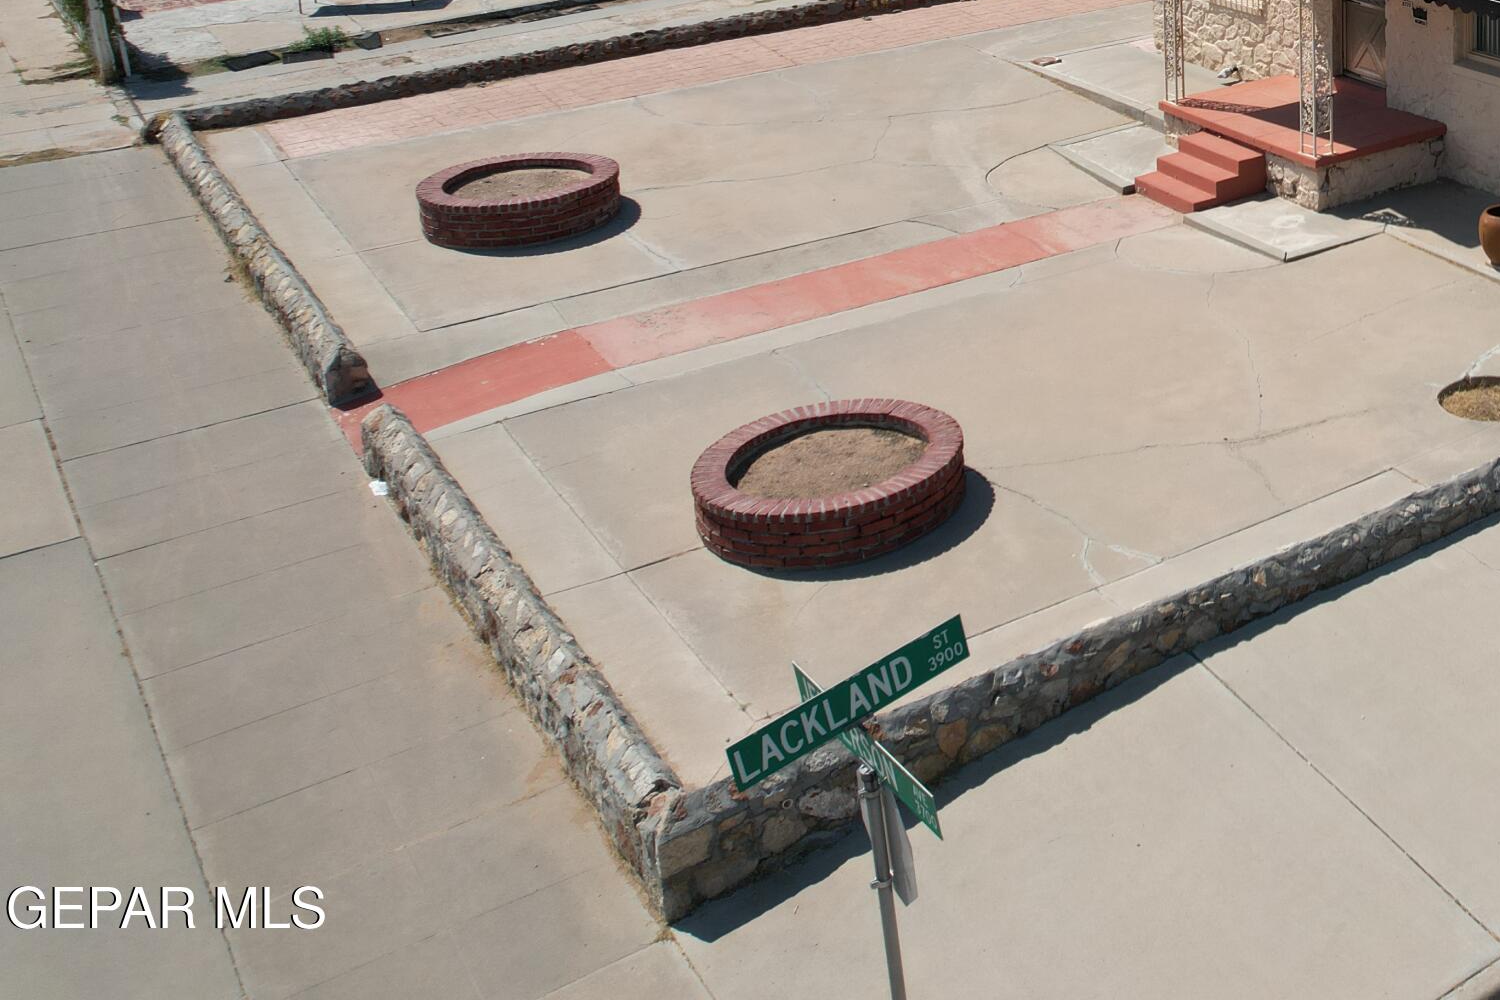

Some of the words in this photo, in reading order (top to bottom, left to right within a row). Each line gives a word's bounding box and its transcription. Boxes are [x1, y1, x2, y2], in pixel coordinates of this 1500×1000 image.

[931, 629, 950, 650] ST
[927, 642, 964, 673] 3900
[733, 655, 914, 785] LACKLAND
